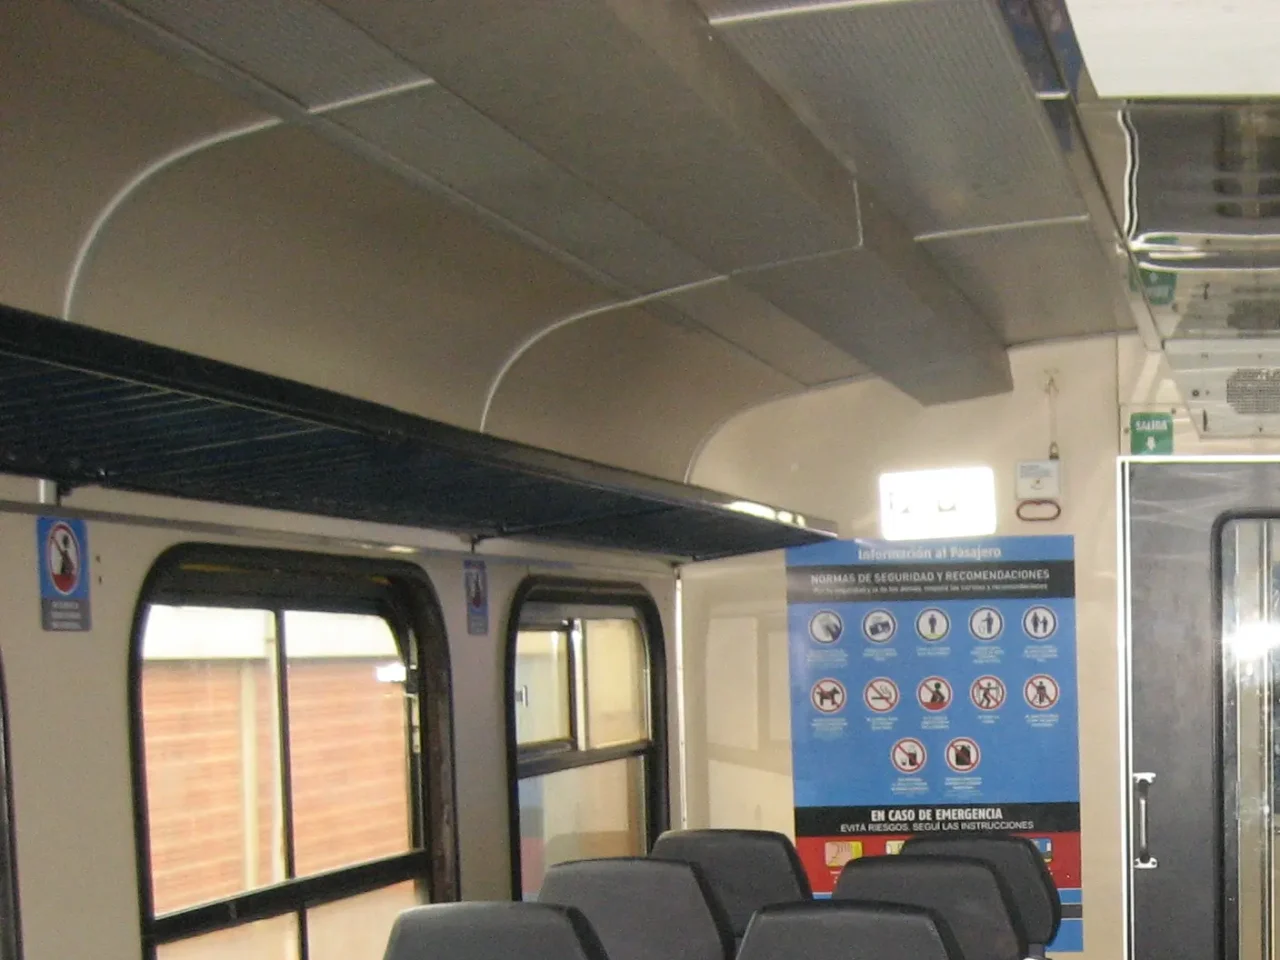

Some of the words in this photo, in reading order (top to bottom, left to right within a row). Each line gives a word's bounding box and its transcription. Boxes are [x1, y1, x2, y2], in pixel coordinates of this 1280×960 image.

[1135, 419, 1168, 431] SALIDA
[858, 546, 932, 560] Información
[935, 547, 947, 558] al
[951, 546, 1001, 560] Pasajero
[811, 573, 855, 585] NORMAS
[858, 572, 872, 583] DE
[875, 571, 934, 583] SEGURIDAD
[936, 571, 944, 581] Y
[946, 569, 1050, 581] RECOMENDACIONES
[871, 810, 886, 822] EN
[888, 809, 915, 821] CASO
[919, 808, 933, 820] DE
[935, 807, 1003, 820] EMERGENCIA
[942, 821, 959, 831] LAS
[961, 820, 1034, 831] INSTRUCCIONES
